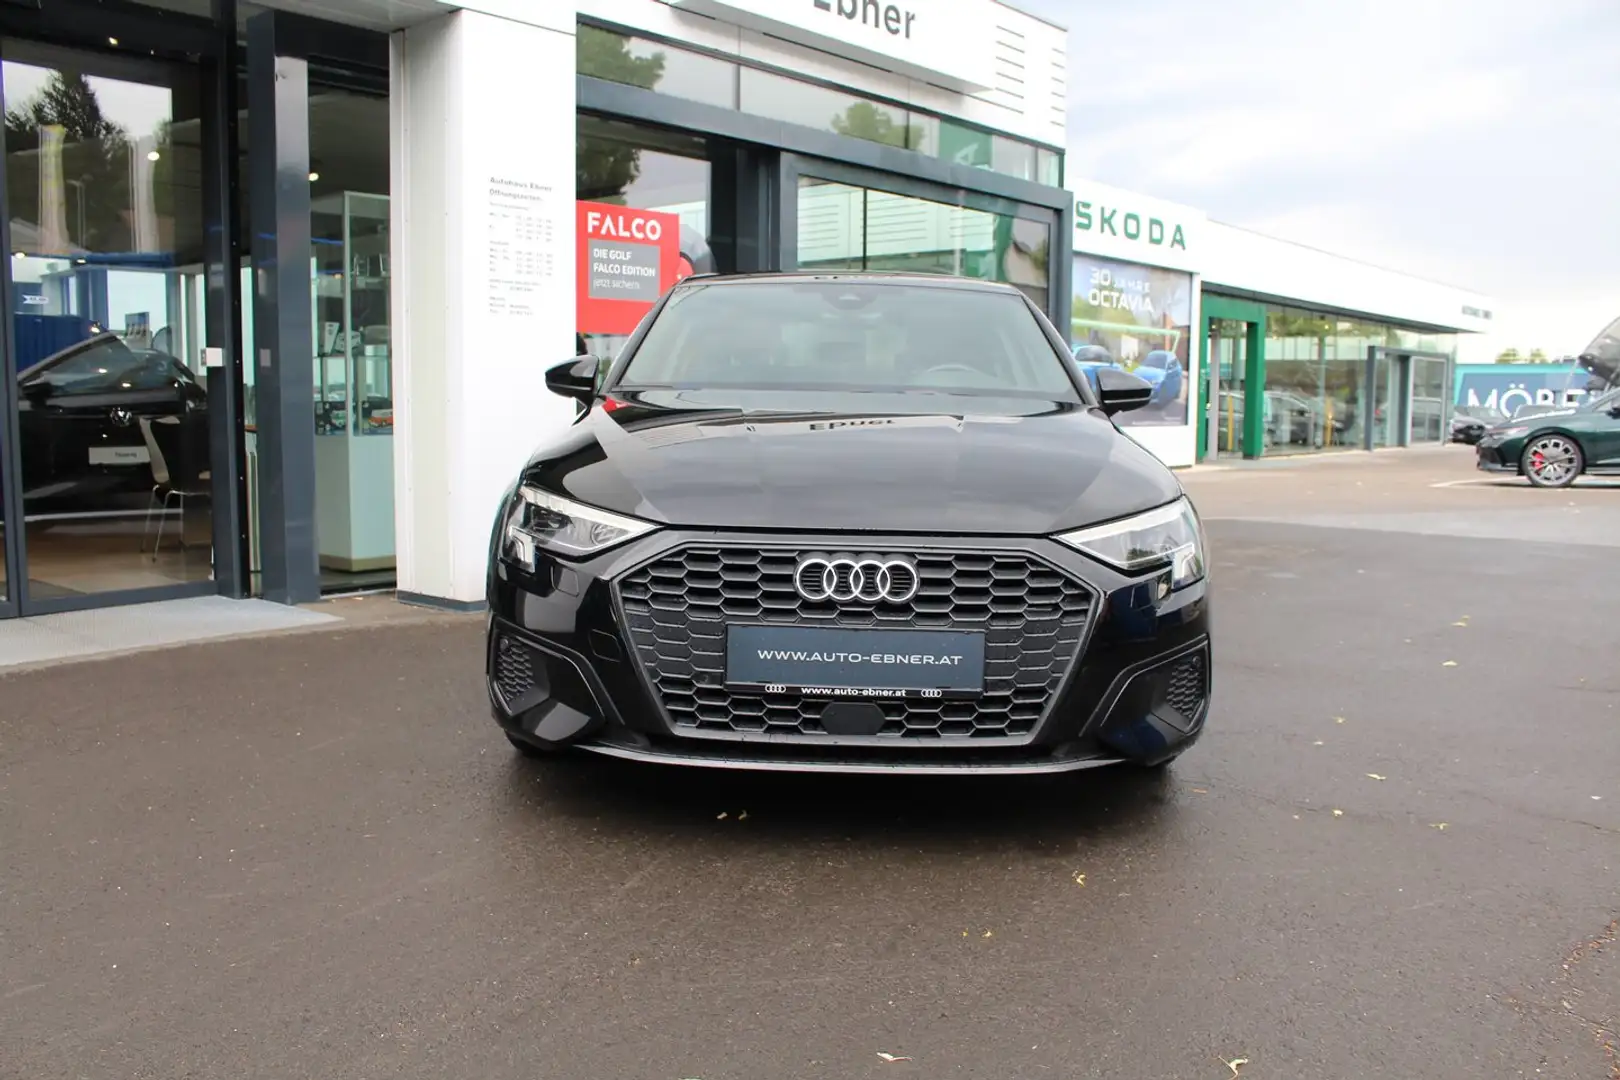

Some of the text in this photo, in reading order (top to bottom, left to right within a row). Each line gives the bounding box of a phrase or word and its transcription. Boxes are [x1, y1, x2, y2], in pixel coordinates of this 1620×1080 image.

[814, 0, 916, 39] bner
[588, 211, 661, 240] FALCO
[593, 248, 632, 261] DIE GOLF
[593, 262, 656, 277] FALCO EDITION
[1088, 289, 1154, 312] OCTAVIA
[1467, 383, 1596, 418] MÖBE
[757, 649, 963, 666] WWW.AUTO-EBNER.AT
[801, 686, 907, 698] www.auto-ebner.at
